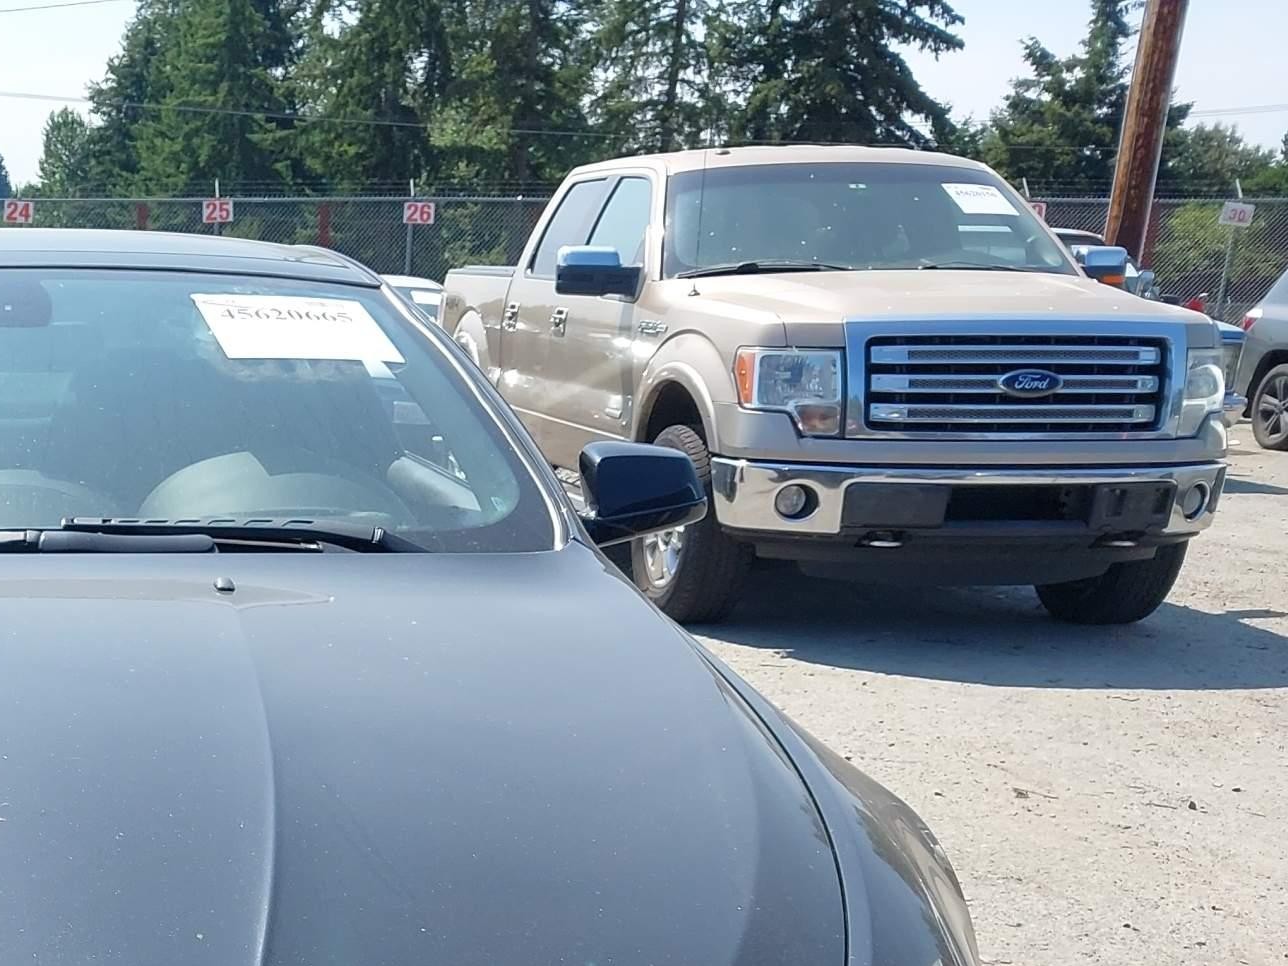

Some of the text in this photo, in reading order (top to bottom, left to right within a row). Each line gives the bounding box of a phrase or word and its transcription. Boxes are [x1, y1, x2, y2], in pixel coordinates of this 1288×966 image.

[6, 202, 31, 222] 24
[205, 202, 230, 223] 25
[406, 203, 431, 223] 26
[1229, 208, 1246, 222] 30
[1014, 374, 1050, 389] Ford
